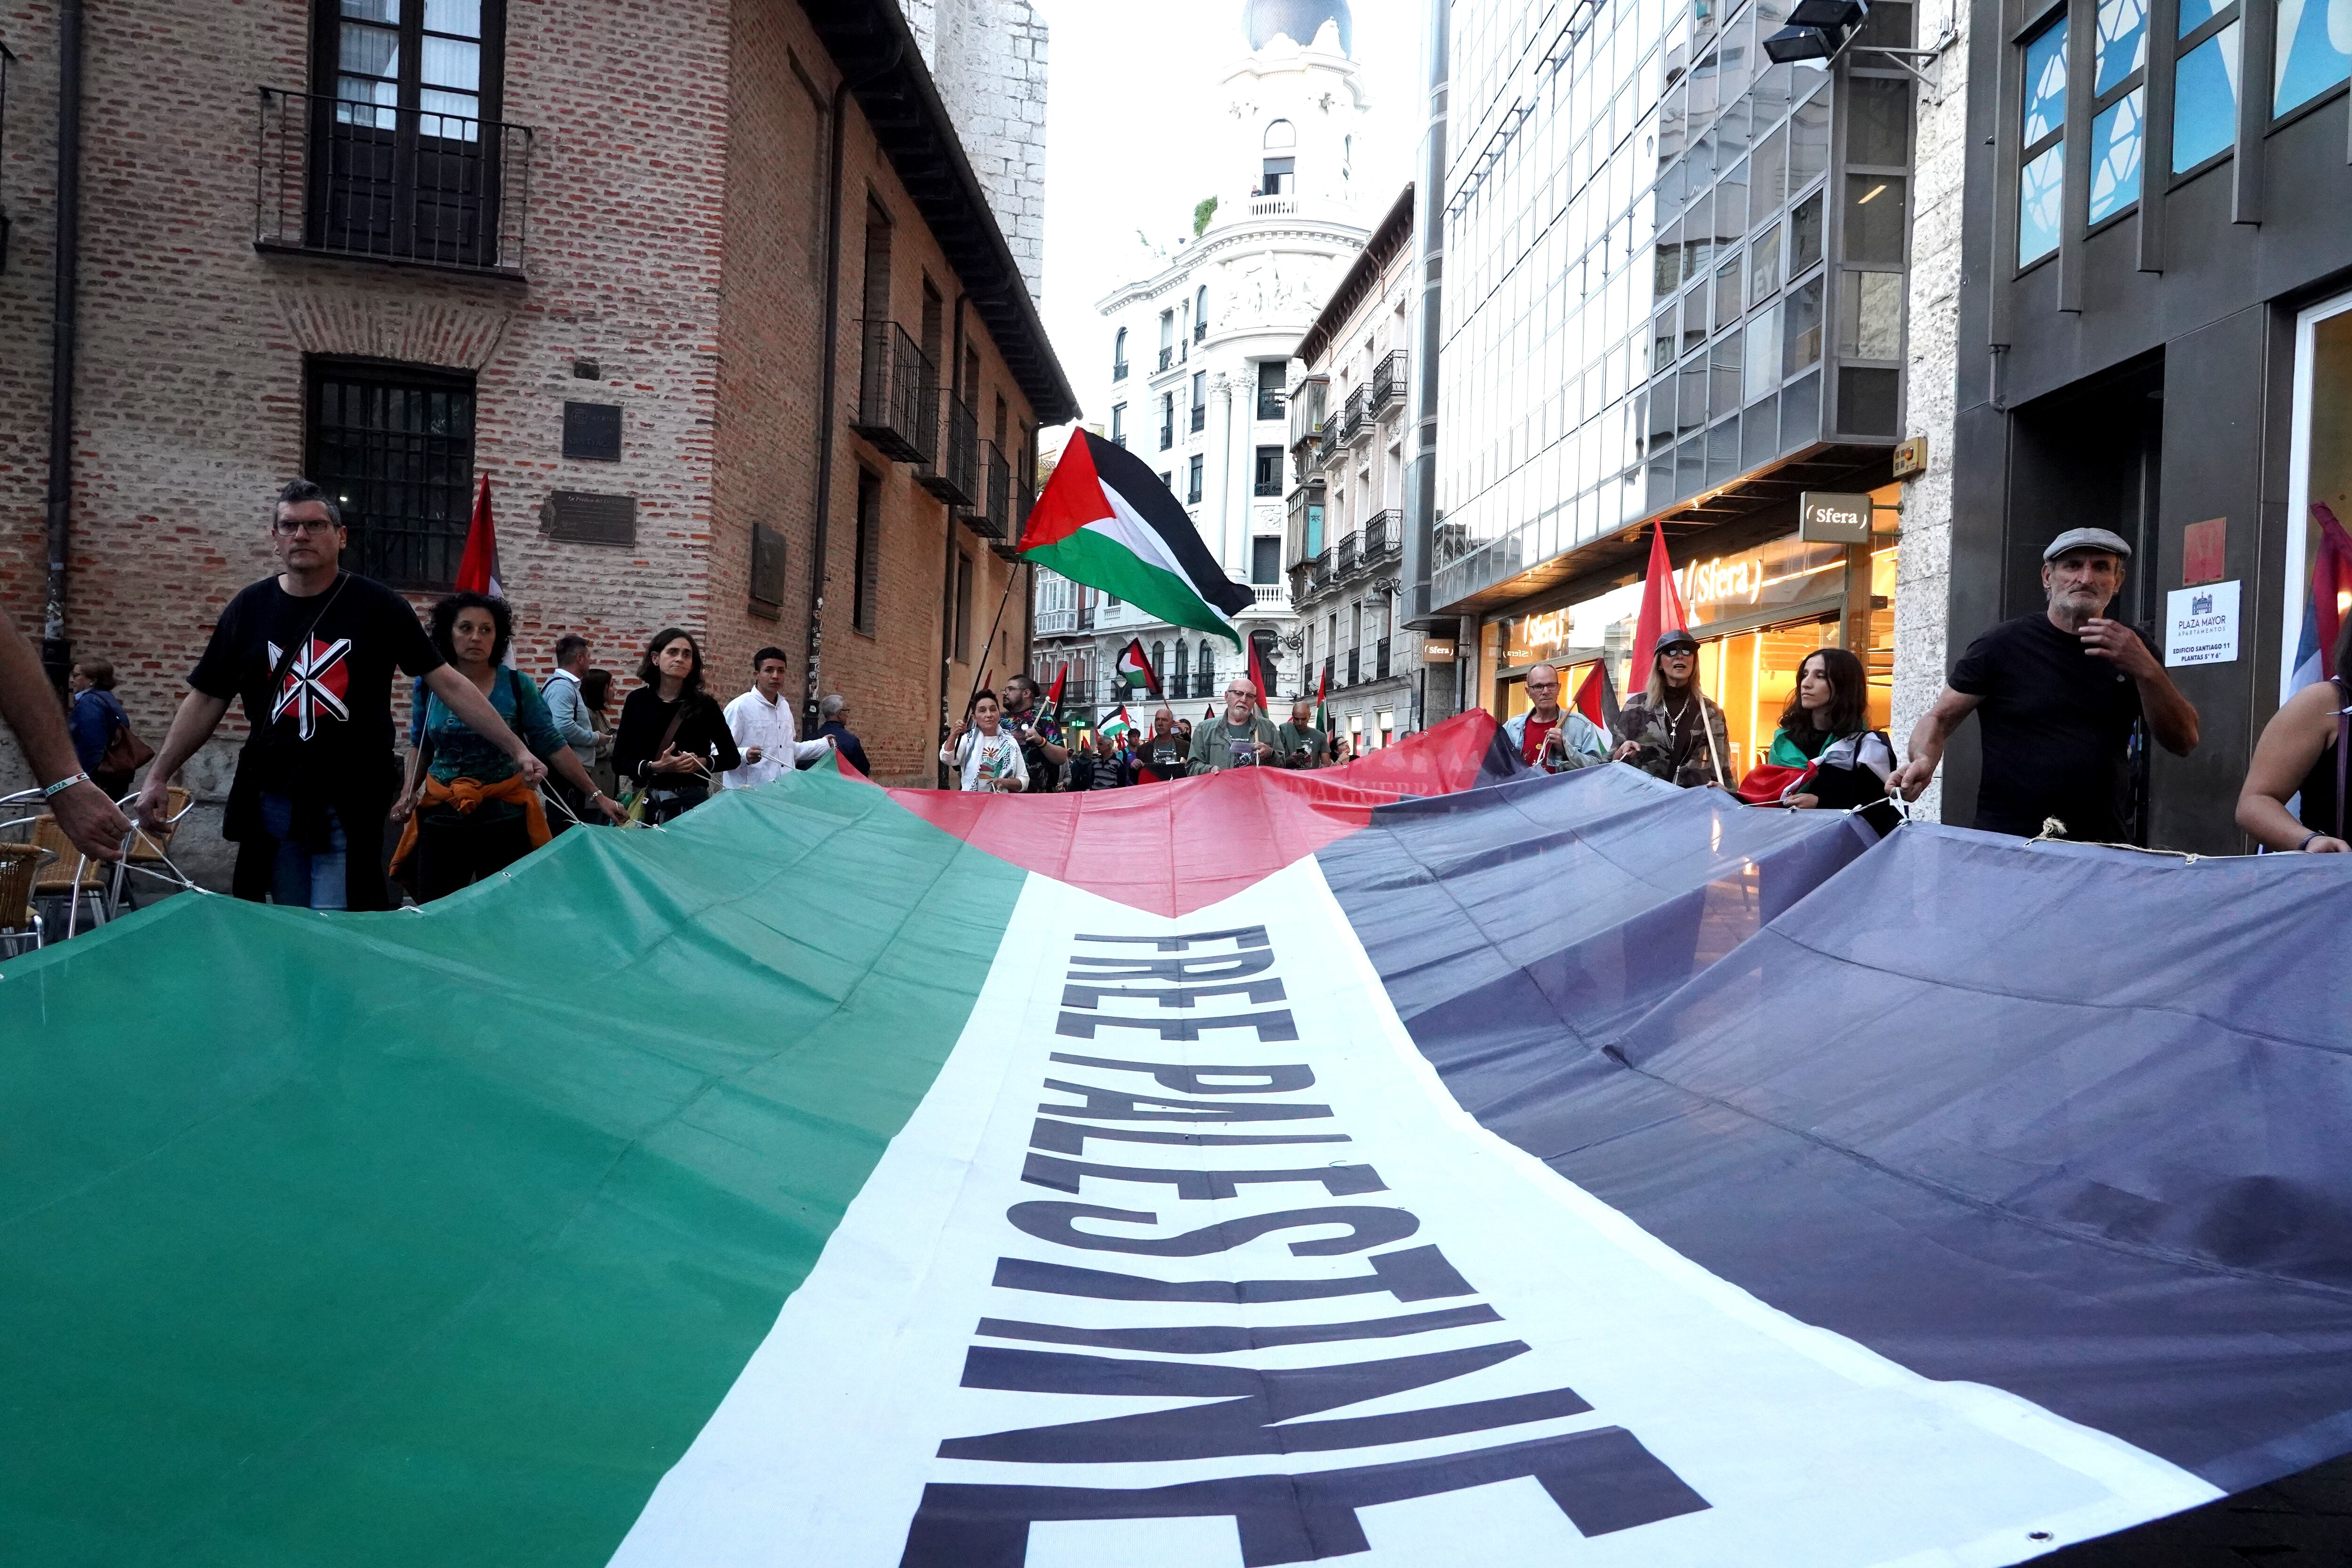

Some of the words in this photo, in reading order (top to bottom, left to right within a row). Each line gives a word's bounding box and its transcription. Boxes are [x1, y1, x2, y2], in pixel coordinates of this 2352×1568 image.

[2179, 619, 2199, 629] PLAZA
[2201, 615, 2226, 627] MAYOR
[2178, 626, 2226, 637] APARTAMENTOS
[48, 781, 67, 793] GAZA
[1056, 924, 1299, 1041] FREE
[899, 1052, 1713, 1568] PALESTINE
